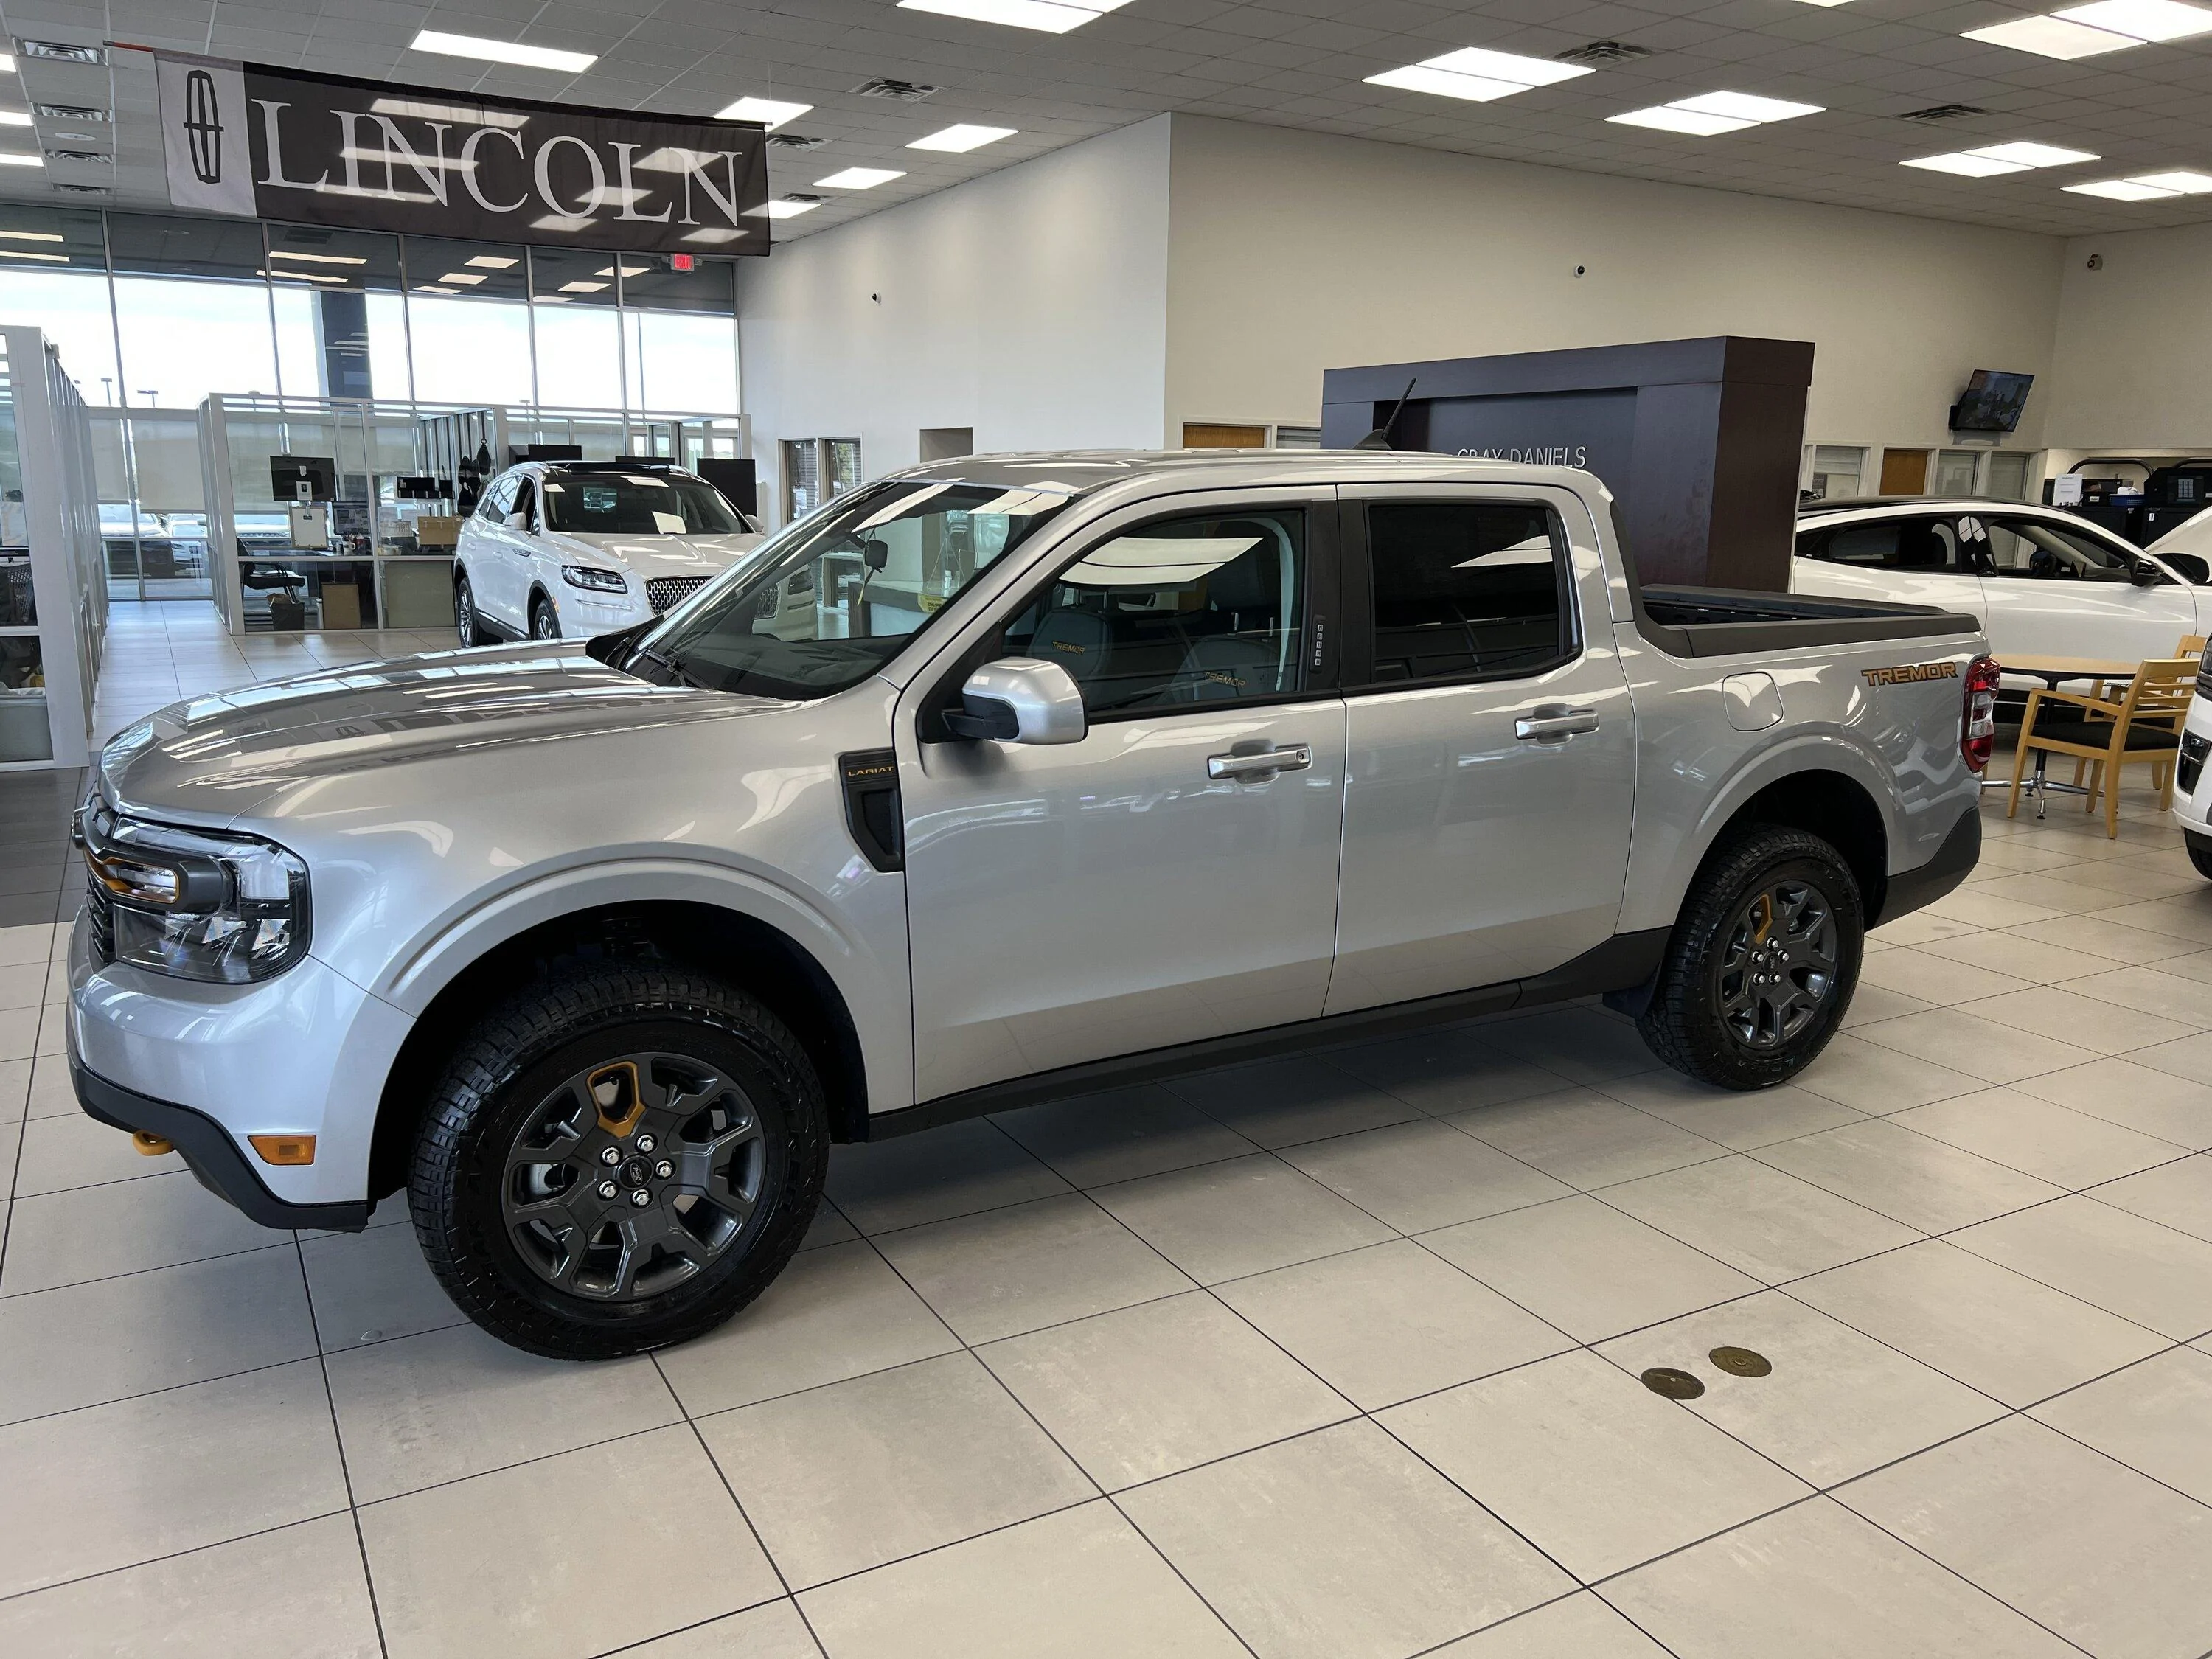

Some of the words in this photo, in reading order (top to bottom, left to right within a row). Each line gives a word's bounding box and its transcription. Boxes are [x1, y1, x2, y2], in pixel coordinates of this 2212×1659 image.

[251, 98, 742, 227] LINCOLN
[1510, 446, 1586, 467] DANIELS
[1052, 641, 1085, 654] TREMOR
[1203, 671, 1246, 688] TREMOR
[1861, 662, 1958, 686] TREMOR
[848, 766, 894, 776] LARIAT
